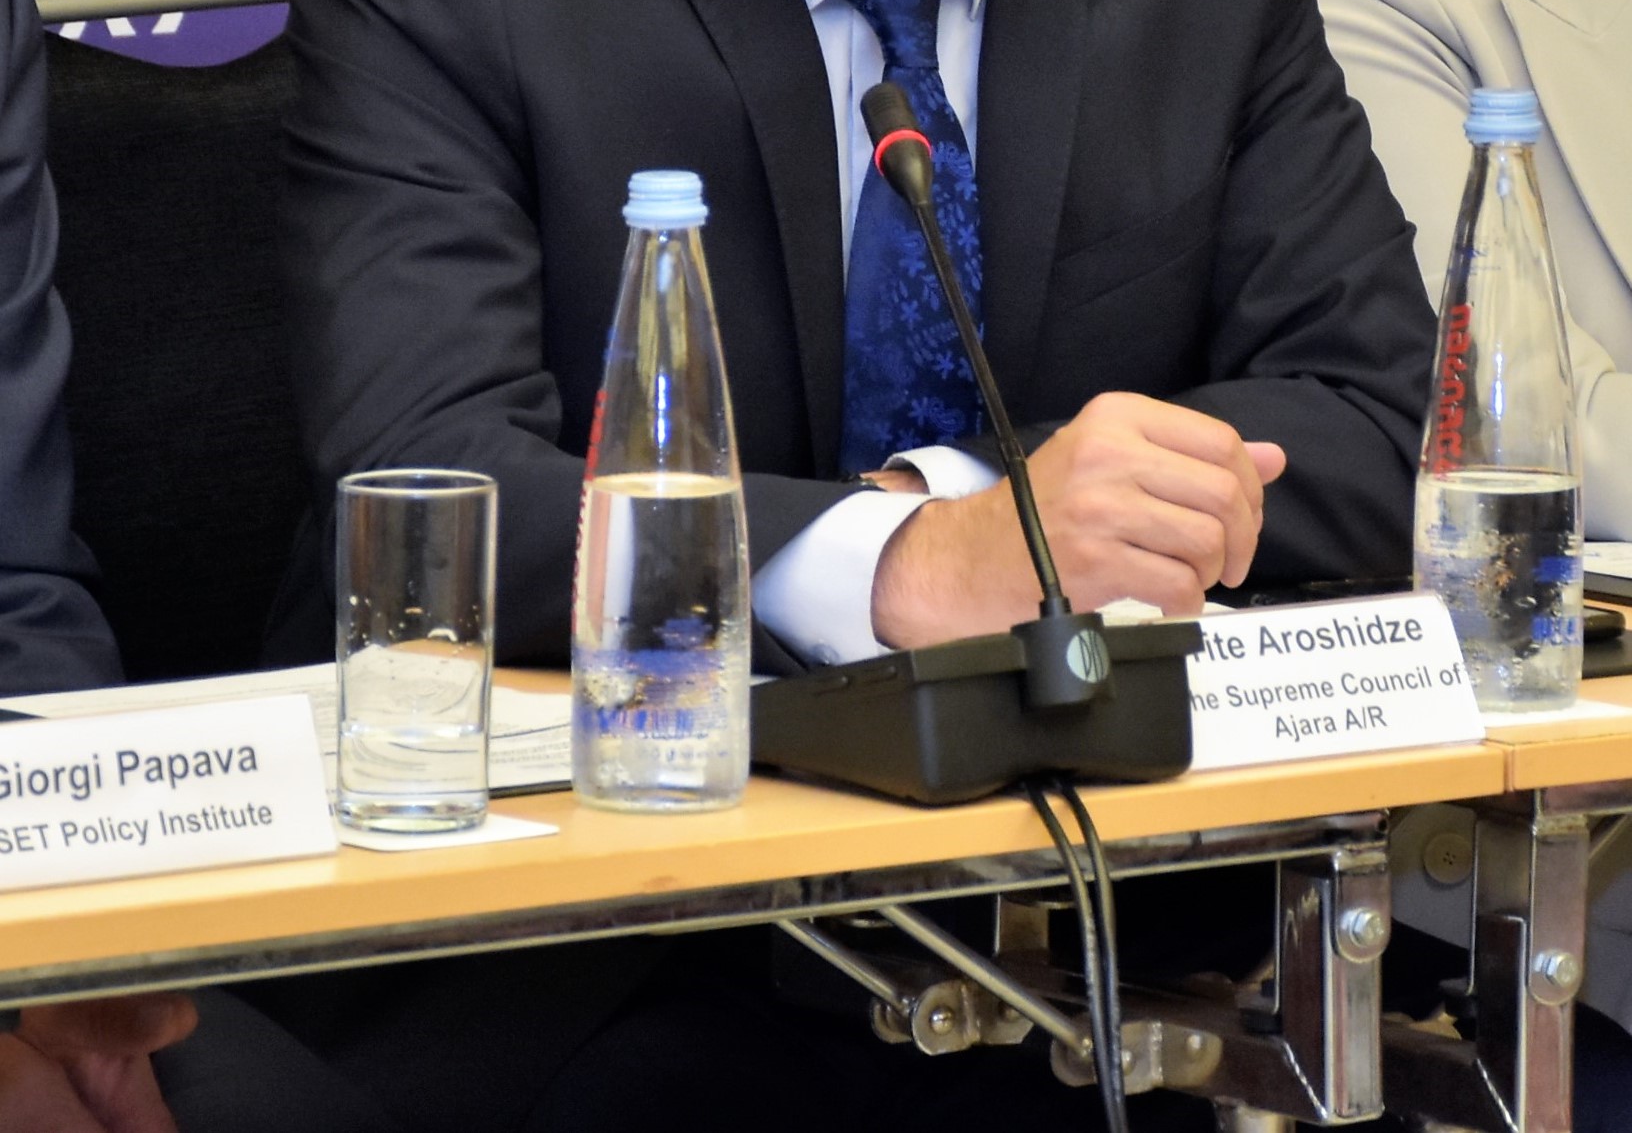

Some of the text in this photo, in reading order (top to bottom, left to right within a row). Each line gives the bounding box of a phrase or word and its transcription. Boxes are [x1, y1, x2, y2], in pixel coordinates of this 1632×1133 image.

[1259, 614, 1423, 657] Aroshidze
[1189, 661, 1461, 711] he Supreme Council of
[1275, 705, 1387, 742] Ajara A/R
[116, 745, 258, 789] Papava
[60, 817, 148, 847] Policy
[159, 803, 273, 836] Institute
